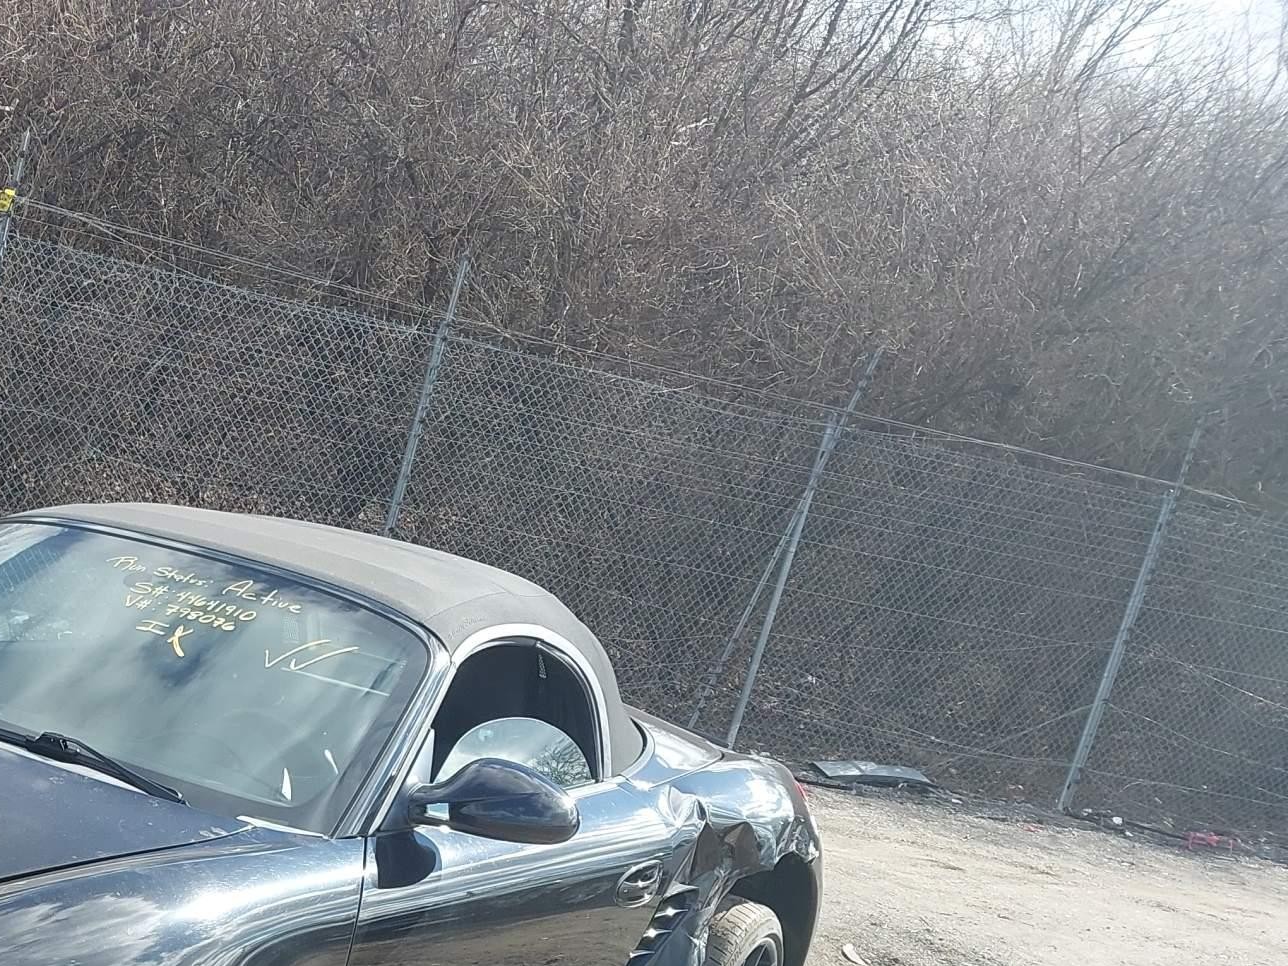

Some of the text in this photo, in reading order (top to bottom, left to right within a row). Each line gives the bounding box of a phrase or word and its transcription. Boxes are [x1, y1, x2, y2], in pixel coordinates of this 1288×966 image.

[106, 556, 146, 572] Run
[222, 580, 302, 613] Active
[165, 604, 235, 631] 798076
[177, 591, 257, 621] 44641910
